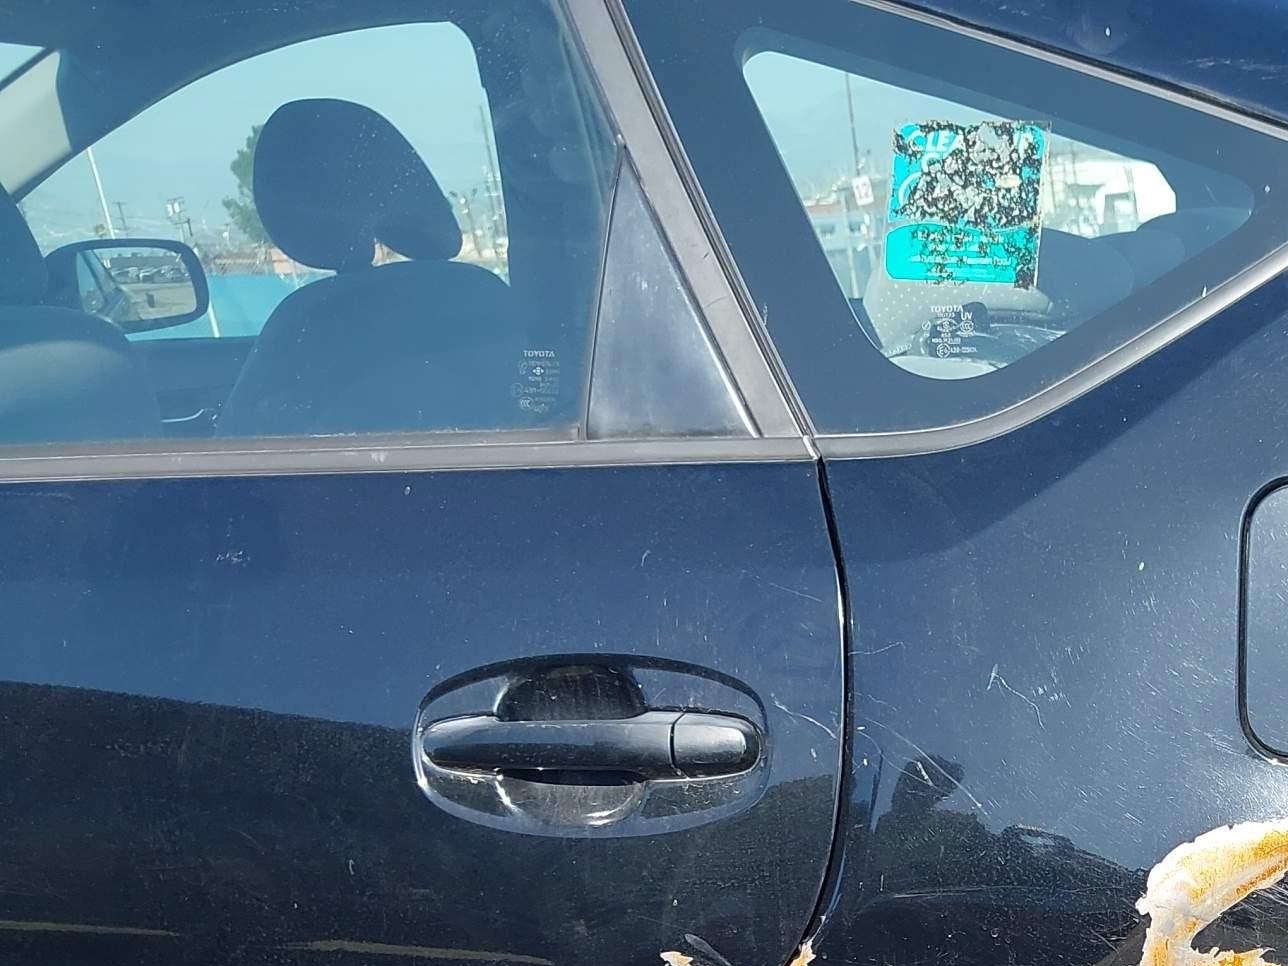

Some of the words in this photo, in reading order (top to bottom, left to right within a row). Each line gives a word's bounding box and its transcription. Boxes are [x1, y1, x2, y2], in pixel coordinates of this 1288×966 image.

[930, 304, 963, 313] TOYOTA
[960, 311, 973, 321] UV
[523, 350, 555, 358] TOYOTA
